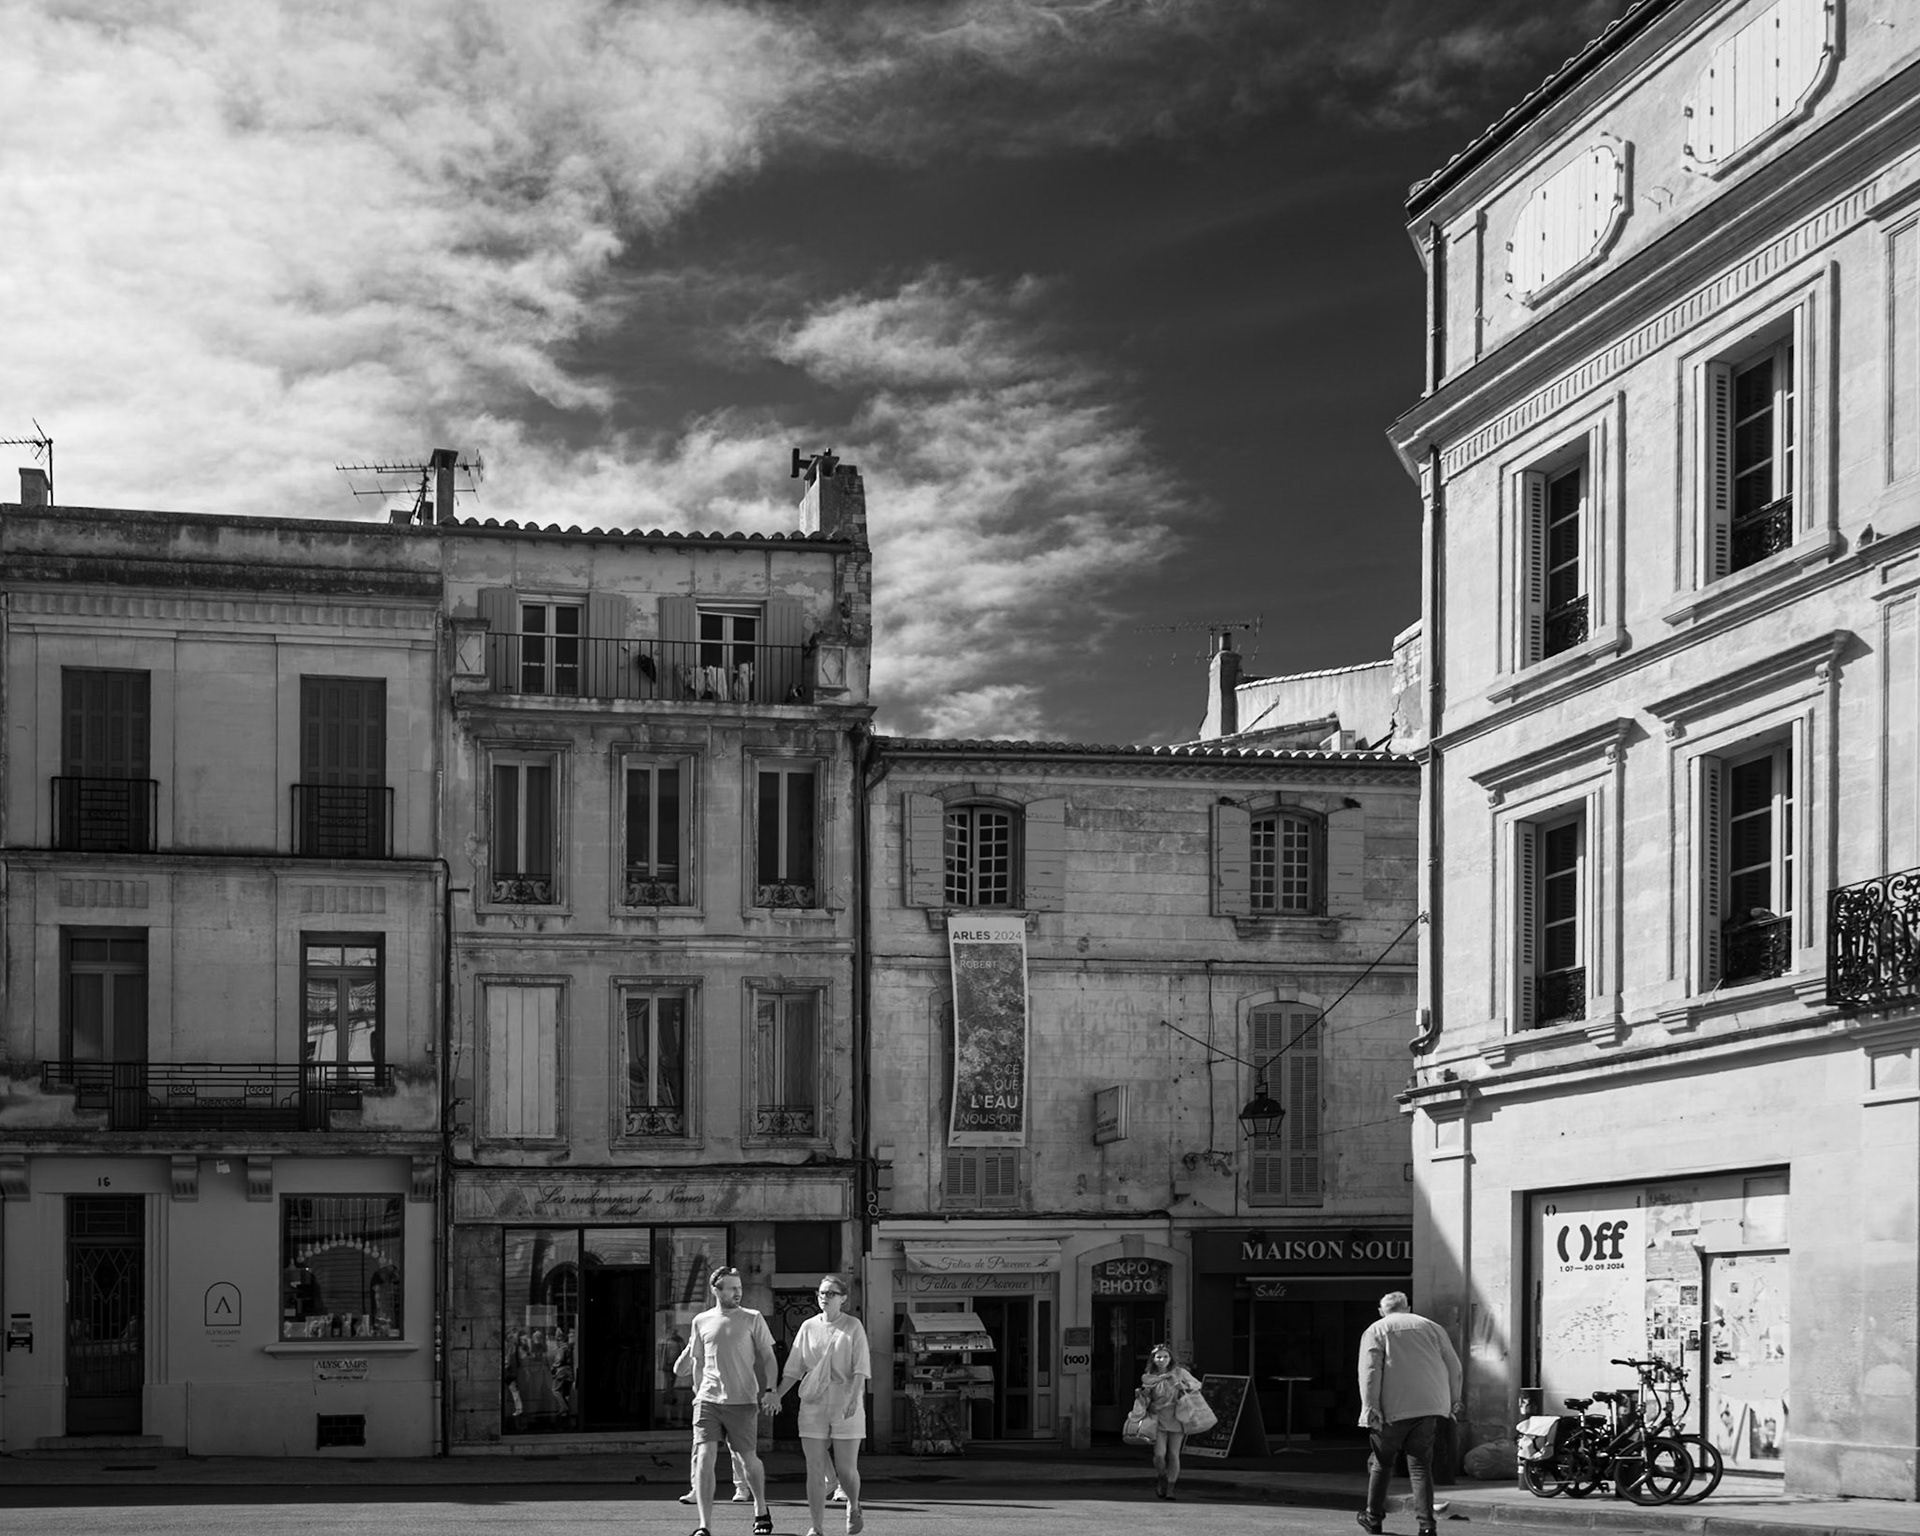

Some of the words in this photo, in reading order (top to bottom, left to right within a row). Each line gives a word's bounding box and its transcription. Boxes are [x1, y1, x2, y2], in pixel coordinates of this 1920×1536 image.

[953, 931, 991, 940] ARLES
[994, 931, 1022, 940] 2024
[960, 960, 997, 969] ROBERT
[1004, 1063, 1020, 1075] CE
[994, 1079, 1020, 1091] QUE
[971, 1095, 1019, 1109] L'EAU
[961, 1113, 997, 1125] NOUS
[999, 1113, 1018, 1124] DIT
[98, 1176, 112, 1188] 16
[543, 1185, 566, 1204] Les
[570, 1189, 634, 1205] indiennes
[637, 1188, 653, 1204] de
[1241, 1240, 1345, 1260] MAISON
[940, 1256, 972, 1271] Folies
[975, 1258, 985, 1269] de
[987, 1256, 1032, 1270] Provence
[1106, 1261, 1150, 1275] EXPO
[916, 1274, 957, 1292] Folies
[961, 1277, 974, 1290] de
[975, 1273, 1029, 1290] Provence
[1100, 1279, 1155, 1293] PHOTO
[316, 1360, 368, 1368] ALYSCAMPS
[1064, 1354, 1090, 1366] (100)
